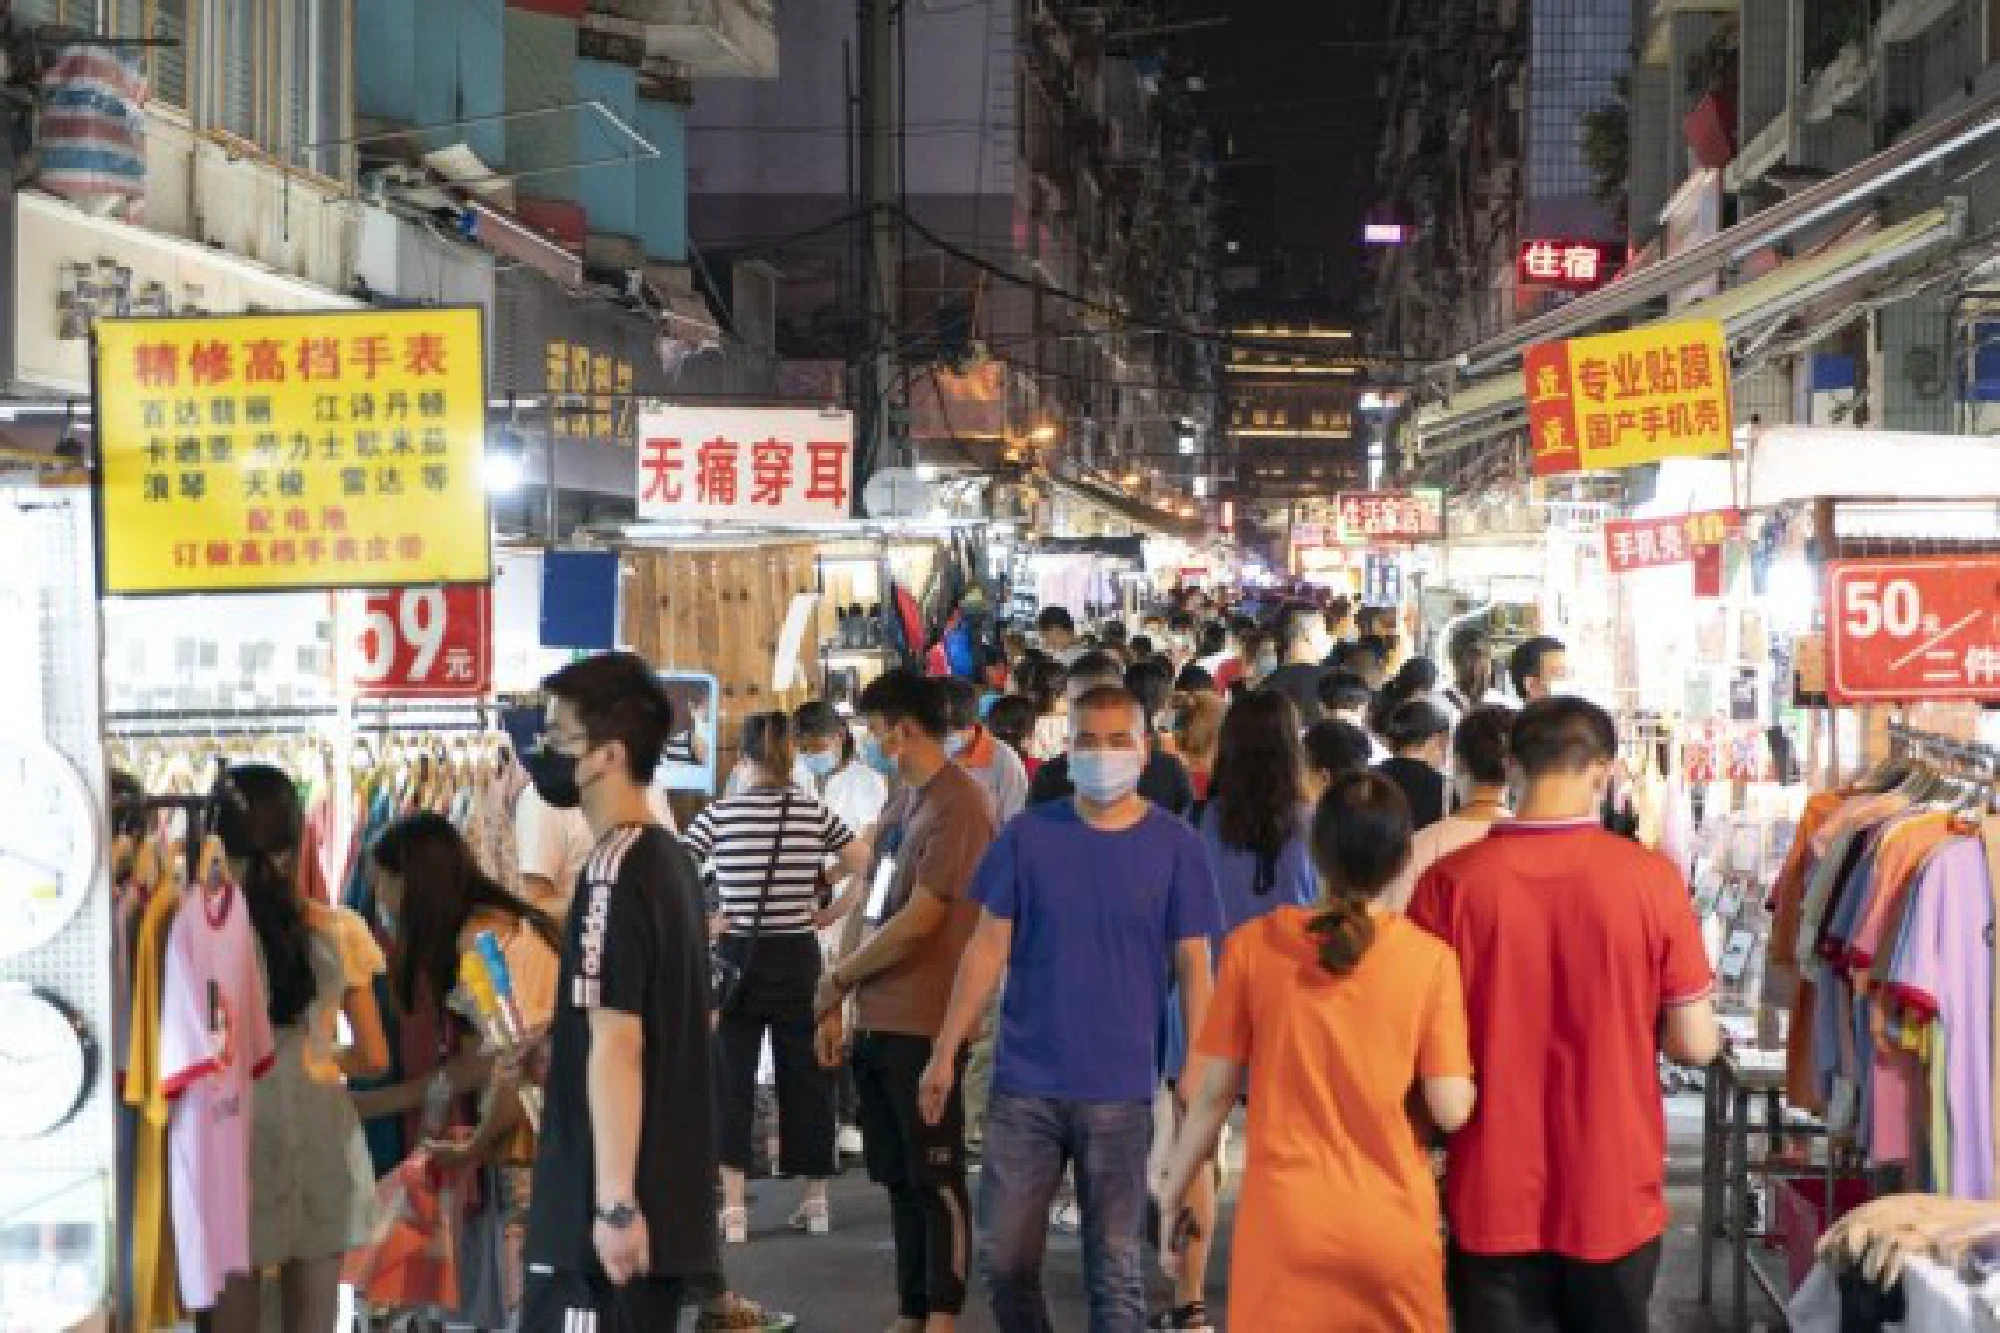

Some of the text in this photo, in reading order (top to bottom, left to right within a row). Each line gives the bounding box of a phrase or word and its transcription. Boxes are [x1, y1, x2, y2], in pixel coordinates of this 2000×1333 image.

[1525, 245, 1597, 282] 住宿
[134, 333, 449, 388] 精修高档手表
[1578, 342, 1713, 403] 专业贴膜
[1585, 399, 1721, 450] 国产手机壳
[641, 435, 848, 510] 无痛穿耳
